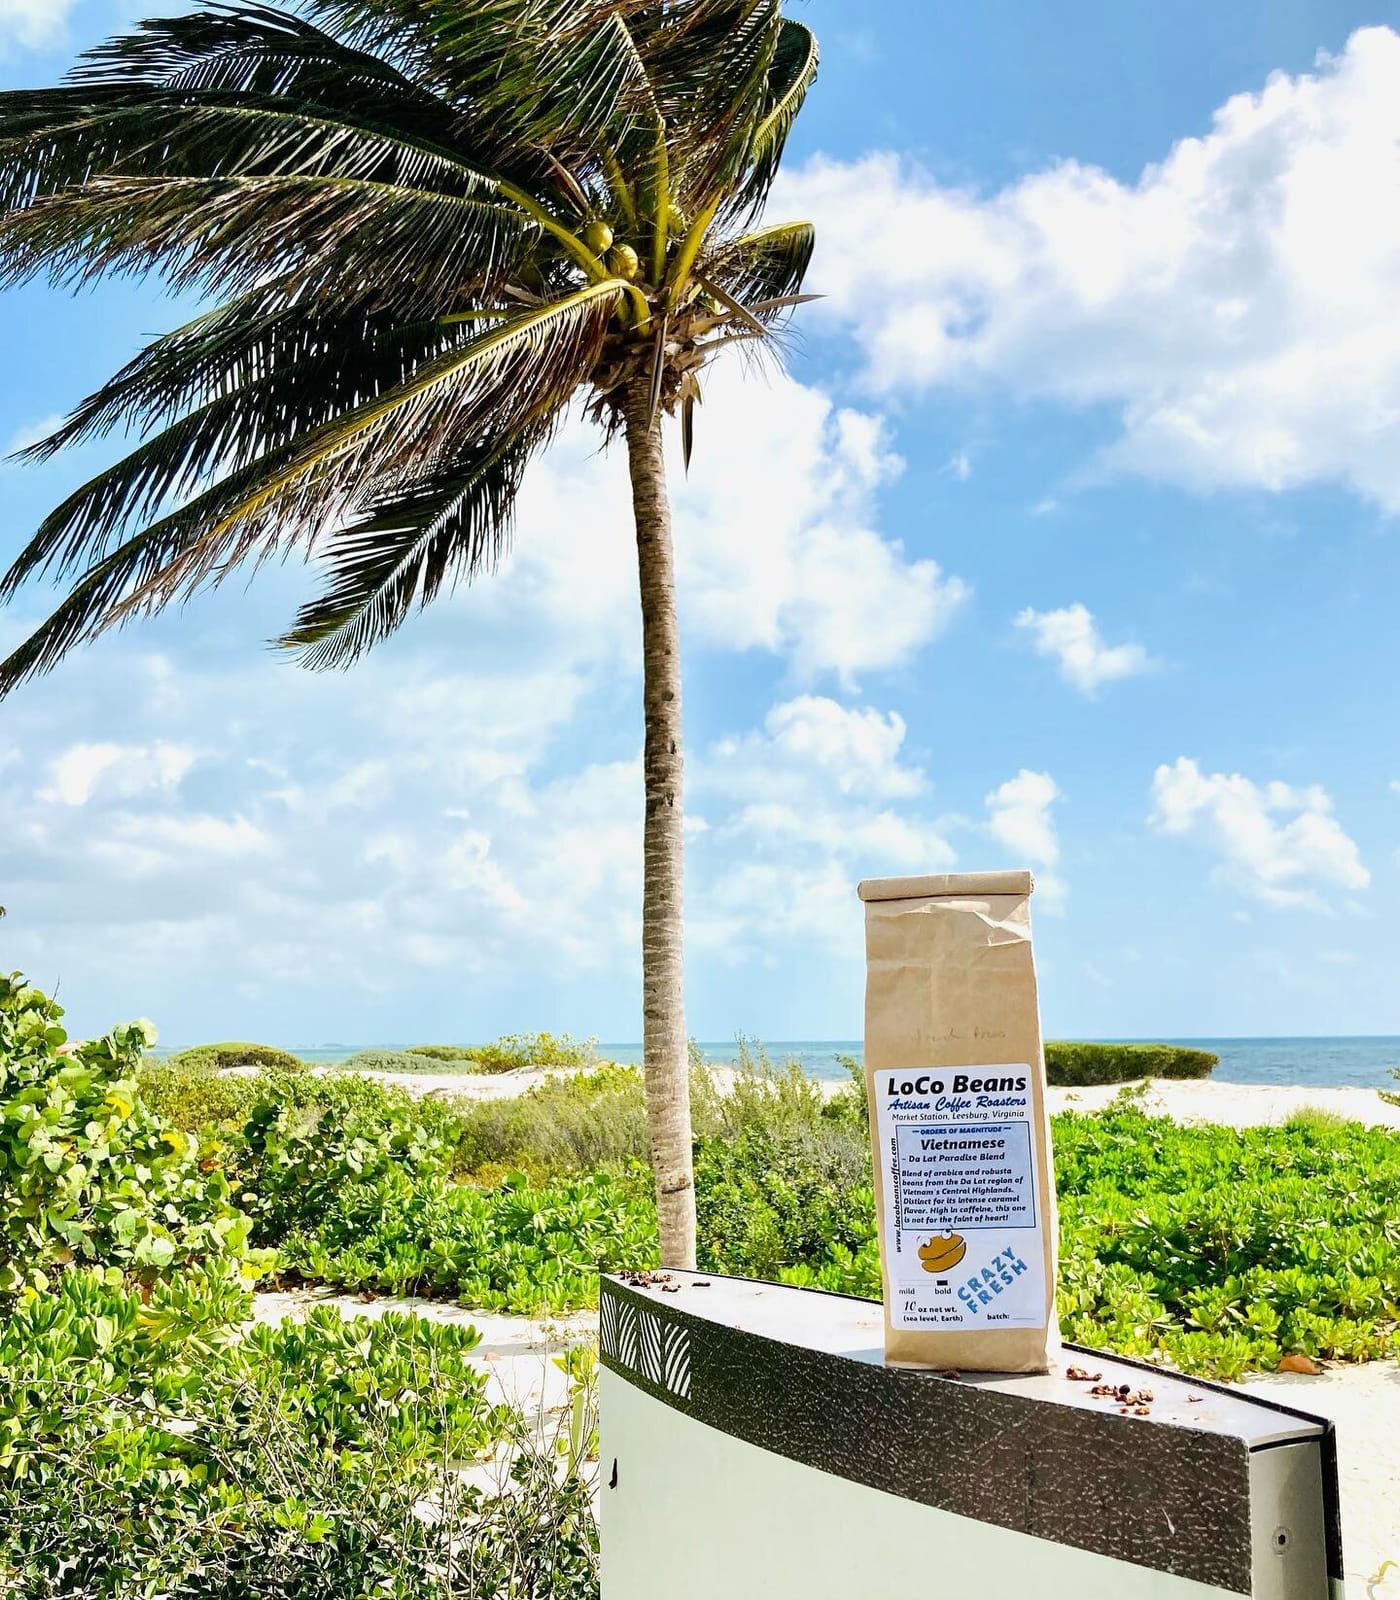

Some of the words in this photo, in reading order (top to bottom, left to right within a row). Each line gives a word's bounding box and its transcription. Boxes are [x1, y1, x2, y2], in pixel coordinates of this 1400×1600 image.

[888, 1077, 945, 1095] LoCo
[953, 1075, 1026, 1093] Beans
[887, 1098, 931, 1111] Artisan
[935, 1096, 971, 1112] Coffee
[976, 1096, 1026, 1107] Roasters
[892, 1112, 918, 1121] Market
[920, 1111, 950, 1120] Station,
[952, 1111, 990, 1120] Leesburg,
[992, 1110, 1024, 1119] Virginia
[921, 1139, 1005, 1151] Vietnamese
[909, 1155, 921, 1163] Da
[923, 1154, 937, 1162] Lat
[939, 1154, 978, 1162] Paradise
[980, 1153, 1005, 1161] Blend
[924, 1170, 933, 1178] of
[934, 1169, 963, 1177] arabica
[925, 1179, 944, 1187] from
[988, 1177, 1013, 1186] region
[1015, 1176, 1023, 1184] of
[891, 1138, 901, 1252] www.locobeanscoffee.com
[972, 1186, 1014, 1195] Highlands.
[933, 1197, 945, 1205] for
[904, 1206, 928, 1215] flavor.
[930, 1206, 949, 1214] High
[960, 1205, 993, 1214] caffeine,
[926, 1216, 938, 1224] for
[953, 1215, 973, 1224] faint
[975, 1215, 983, 1223] of
[985, 1214, 1008, 1222] heart!
[957, 1246, 1016, 1301] CRAZY
[966, 1259, 1028, 1314] FRESH
[929, 1305, 942, 1313] net
[919, 1314, 939, 1322] level,
[941, 1314, 963, 1322] Earth)
